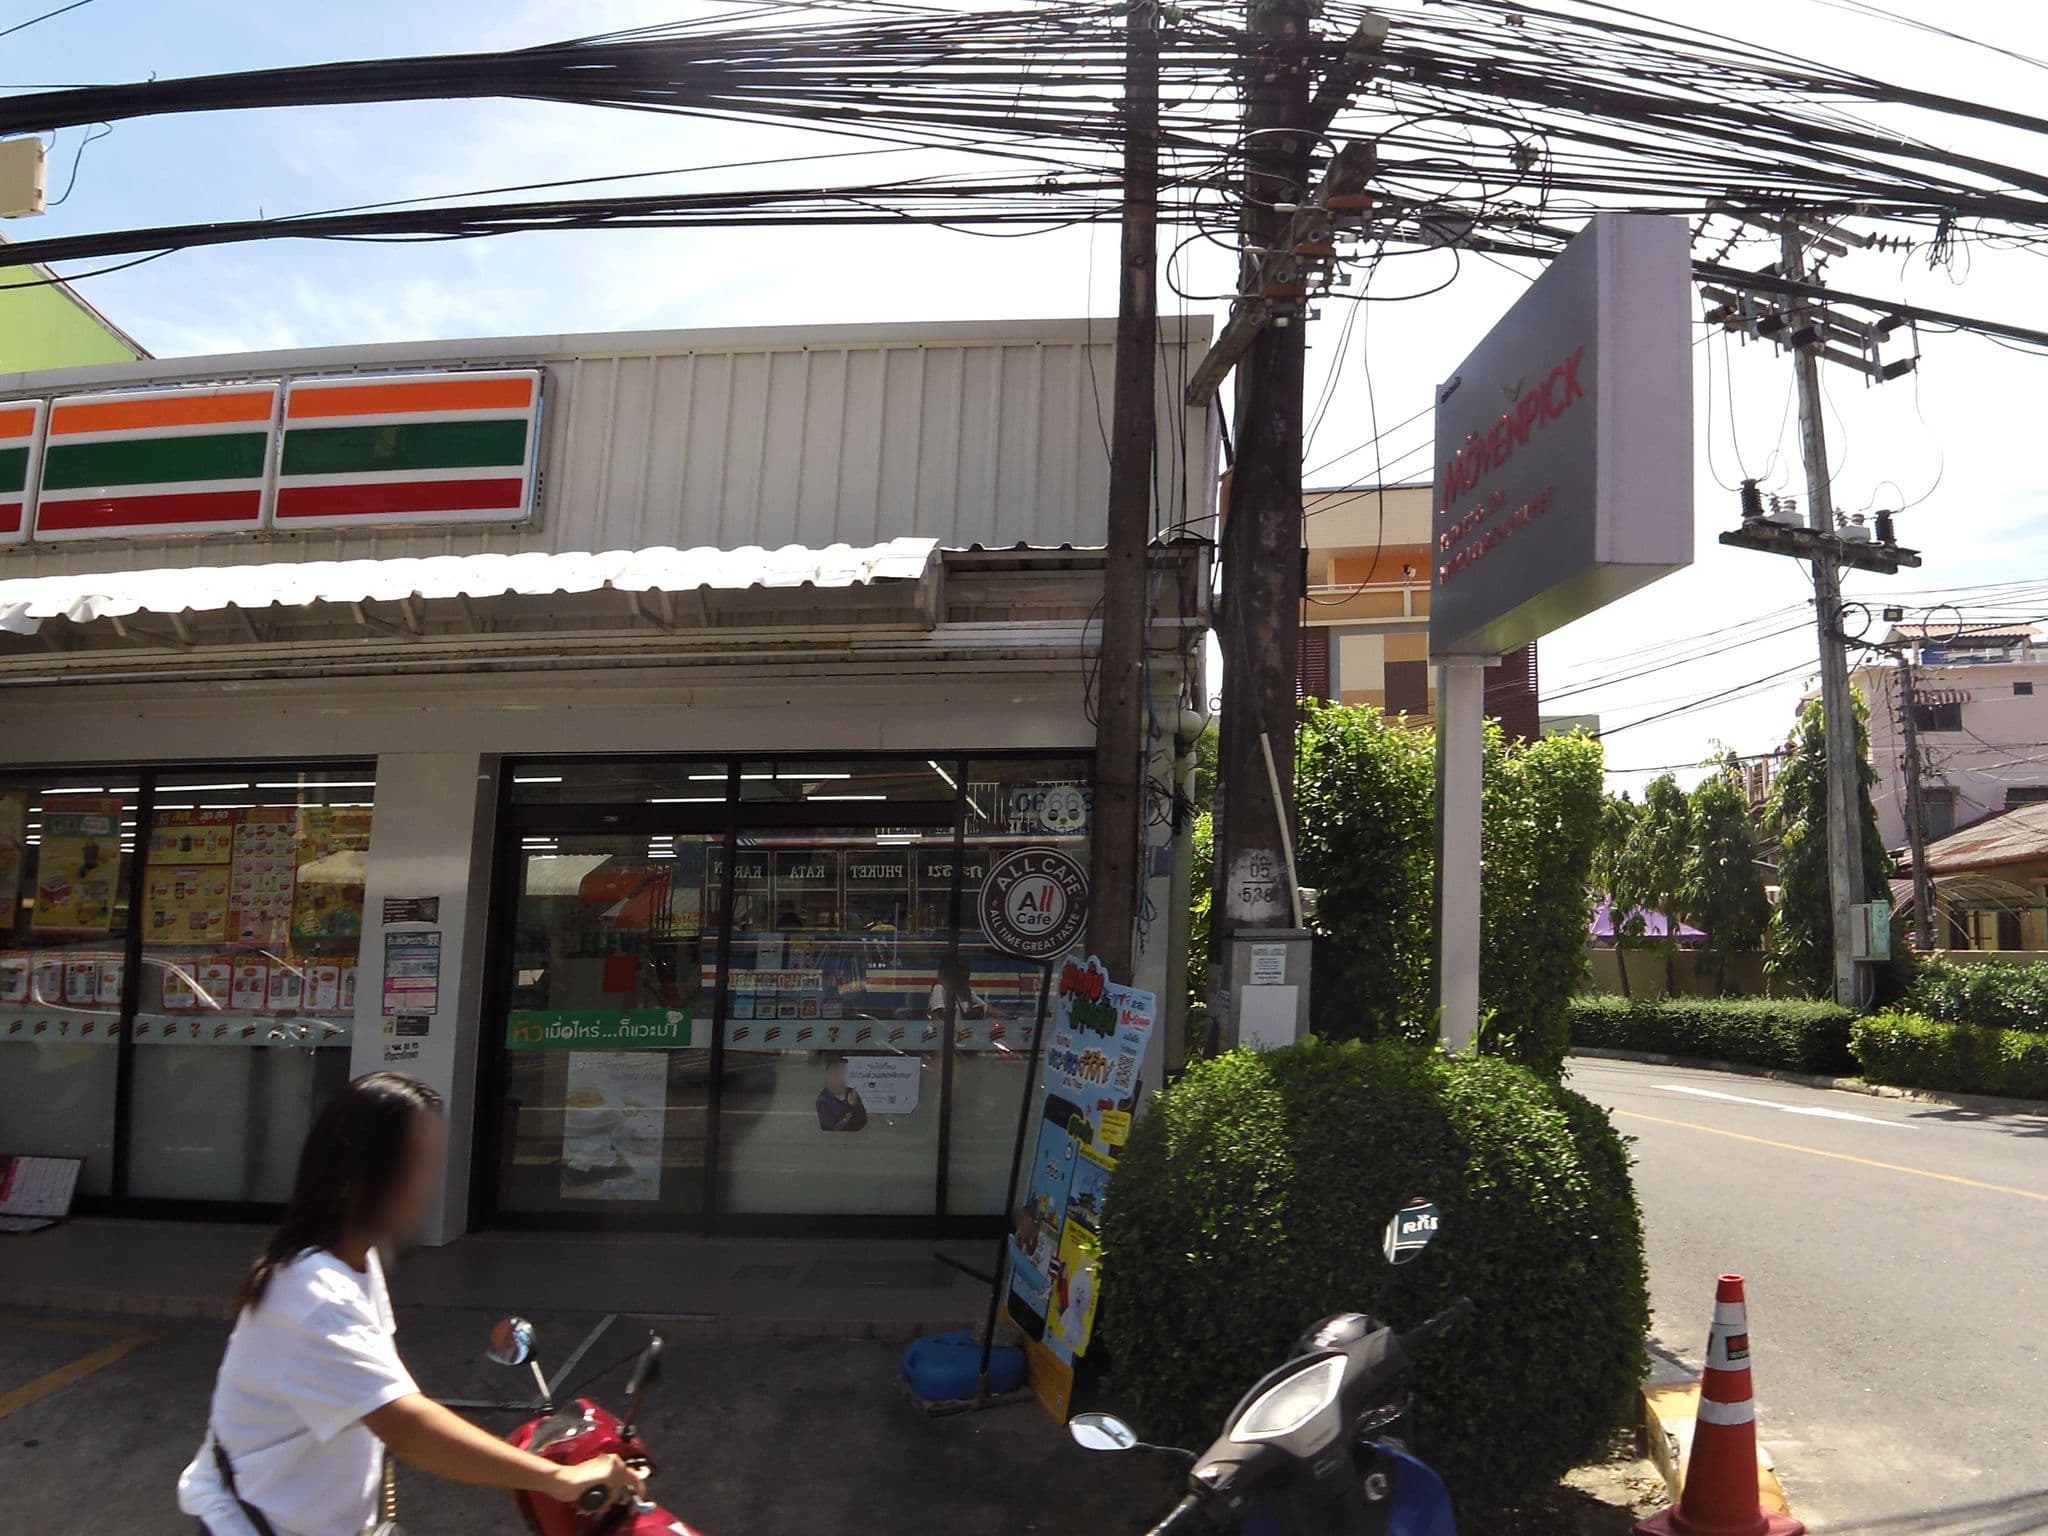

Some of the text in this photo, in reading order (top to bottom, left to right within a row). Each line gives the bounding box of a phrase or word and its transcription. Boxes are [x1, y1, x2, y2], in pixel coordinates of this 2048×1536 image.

[1440, 345, 1585, 514] MÖVENPICK
[997, 858, 1035, 892] ALL
[1250, 862, 1272, 878] 05
[1017, 885, 1055, 912] All
[1242, 888, 1273, 903] 528
[990, 909, 1081, 951] ALL TIME GREAT TASTE
